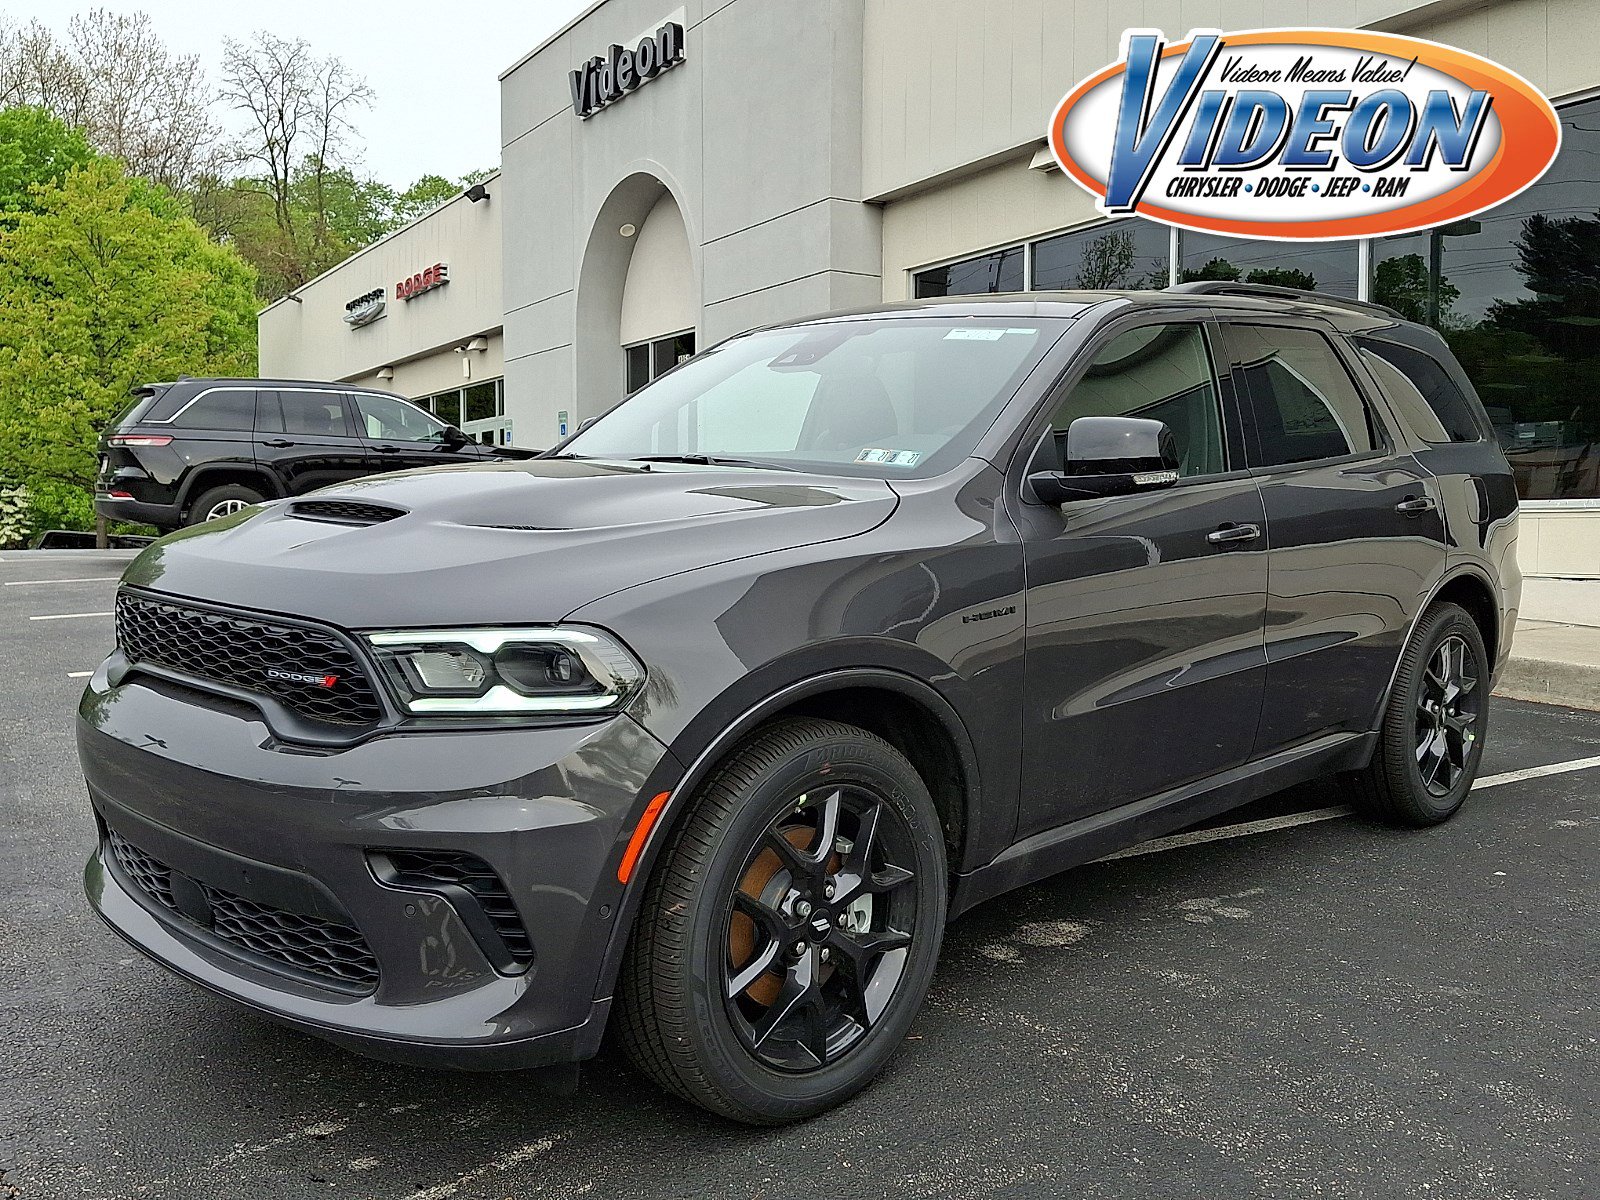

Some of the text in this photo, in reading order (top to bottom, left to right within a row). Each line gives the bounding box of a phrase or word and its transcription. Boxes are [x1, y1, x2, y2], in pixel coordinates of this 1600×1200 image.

[567, 21, 684, 117] Videon
[396, 262, 449, 300] DODGE
[267, 669, 326, 685] DODGE
